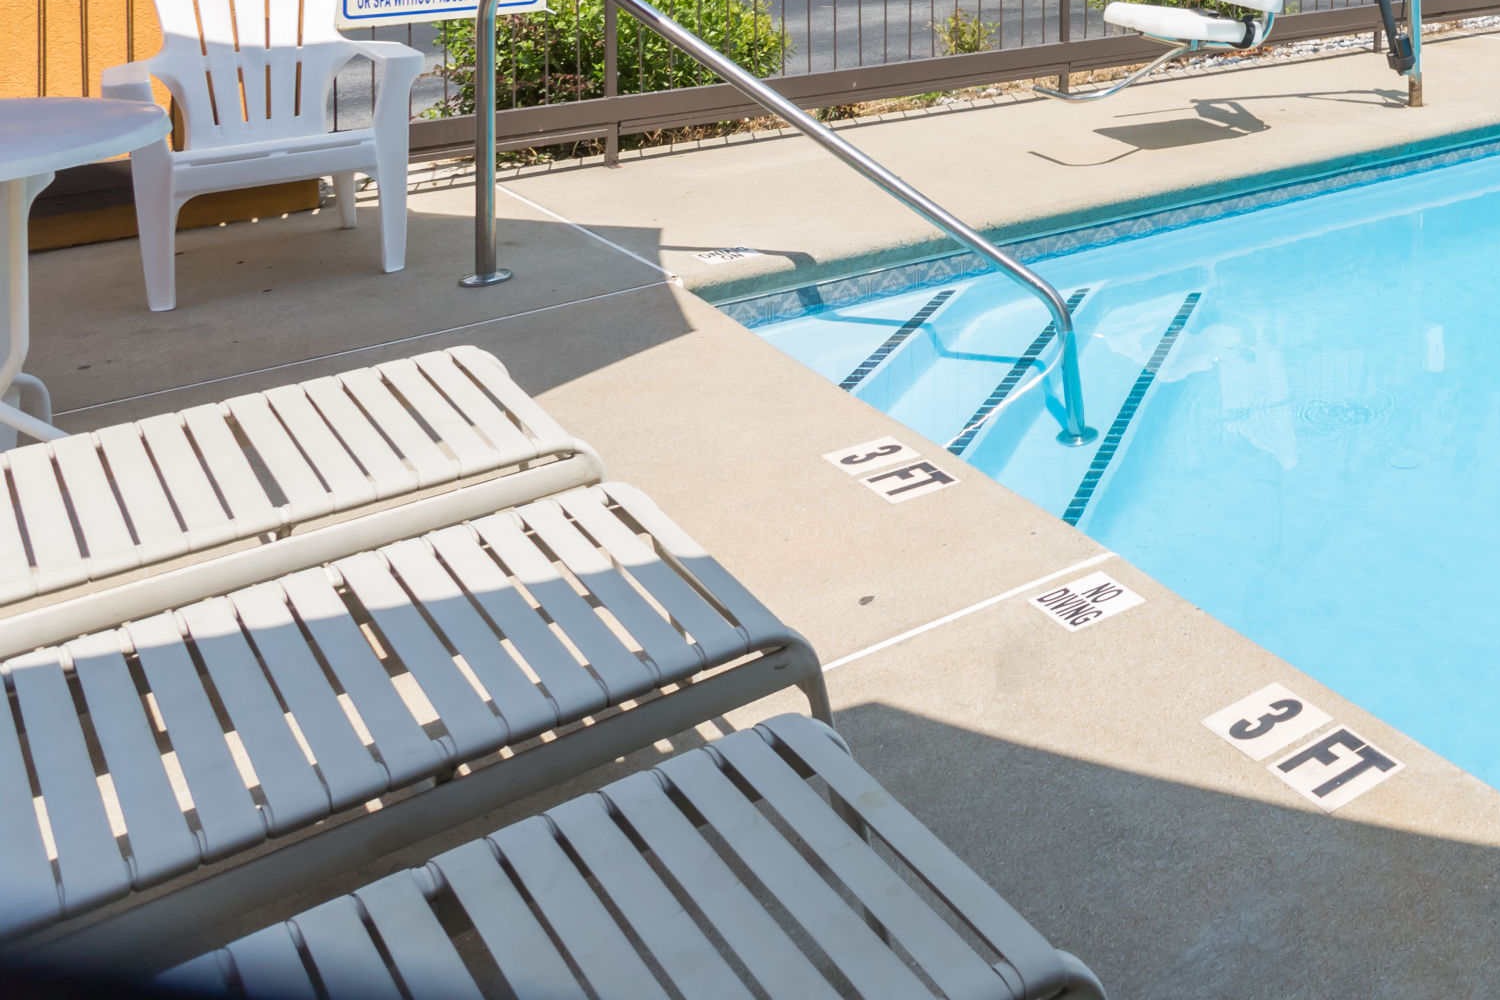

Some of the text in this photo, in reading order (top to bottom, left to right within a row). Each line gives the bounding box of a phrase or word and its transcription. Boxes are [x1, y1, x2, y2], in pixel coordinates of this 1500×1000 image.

[840, 445, 955, 496] 3 FT
[1036, 588, 1103, 626] DIVING
[1080, 582, 1123, 603] NO
[1229, 699, 1397, 798] 3 FT
